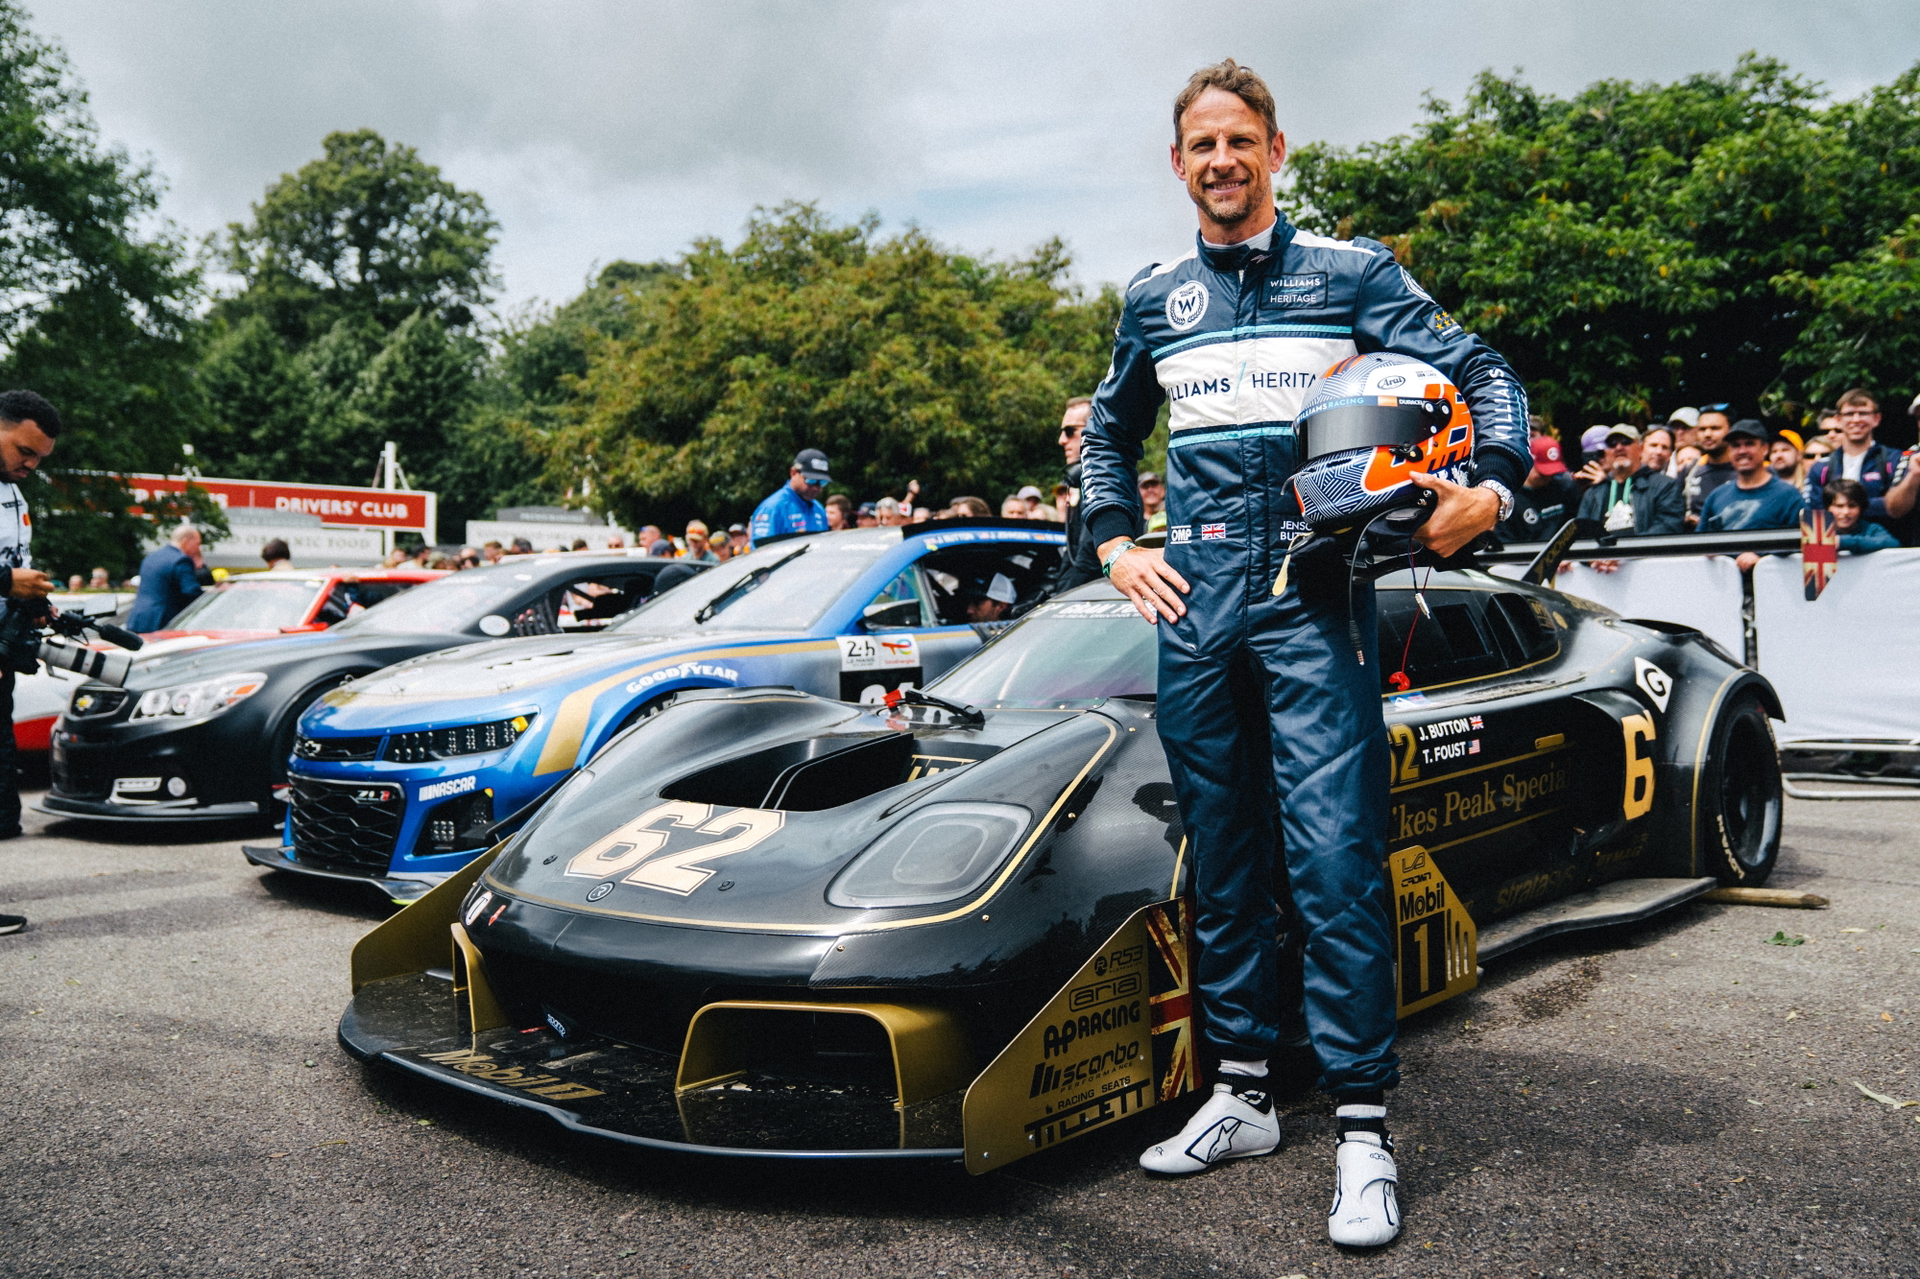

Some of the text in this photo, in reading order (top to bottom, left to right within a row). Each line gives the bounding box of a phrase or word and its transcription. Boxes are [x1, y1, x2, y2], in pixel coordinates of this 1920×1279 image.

[1270, 278, 1321, 288] WILLIAMS
[1178, 296, 1196, 315] W
[1270, 294, 1317, 303] HERITAGE
[1166, 371, 1317, 402] ILLIAMS HERITA
[1382, 375, 1403, 386] Arai
[1296, 403, 1328, 423] WILLIAMS
[1328, 397, 1364, 409] RACING
[275, 496, 358, 517] DRIVERS'
[361, 501, 408, 519] CLUB
[1171, 529, 1192, 541] OMP
[1280, 520, 1313, 532] JENSO
[246, 534, 320, 549] ORNIC
[626, 662, 739, 694] GOODYEAR
[1644, 668, 1666, 697] G
[1419, 717, 1470, 741] J. BUTTON
[1422, 741, 1467, 764] T. FOUST
[431, 775, 477, 799] NASCAR
[1389, 804, 1437, 843] kes
[1443, 780, 1497, 827] Peak
[564, 799, 786, 897] 62
[1401, 872, 1432, 888] CROWN
[1400, 881, 1445, 922] Mobil
[1109, 945, 1143, 969] R53
[1414, 923, 1429, 994] 1
[1073, 977, 1137, 1006] aria
[1078, 1000, 1140, 1040] RACING
[418, 1049, 561, 1088] Mobil
[1061, 1041, 1139, 1087] scarbo
[1061, 1061, 1133, 1093] PERFORMANCE
[1058, 1075, 1131, 1110] RACING SEATS
[1024, 1078, 1150, 1149] TILLETT
